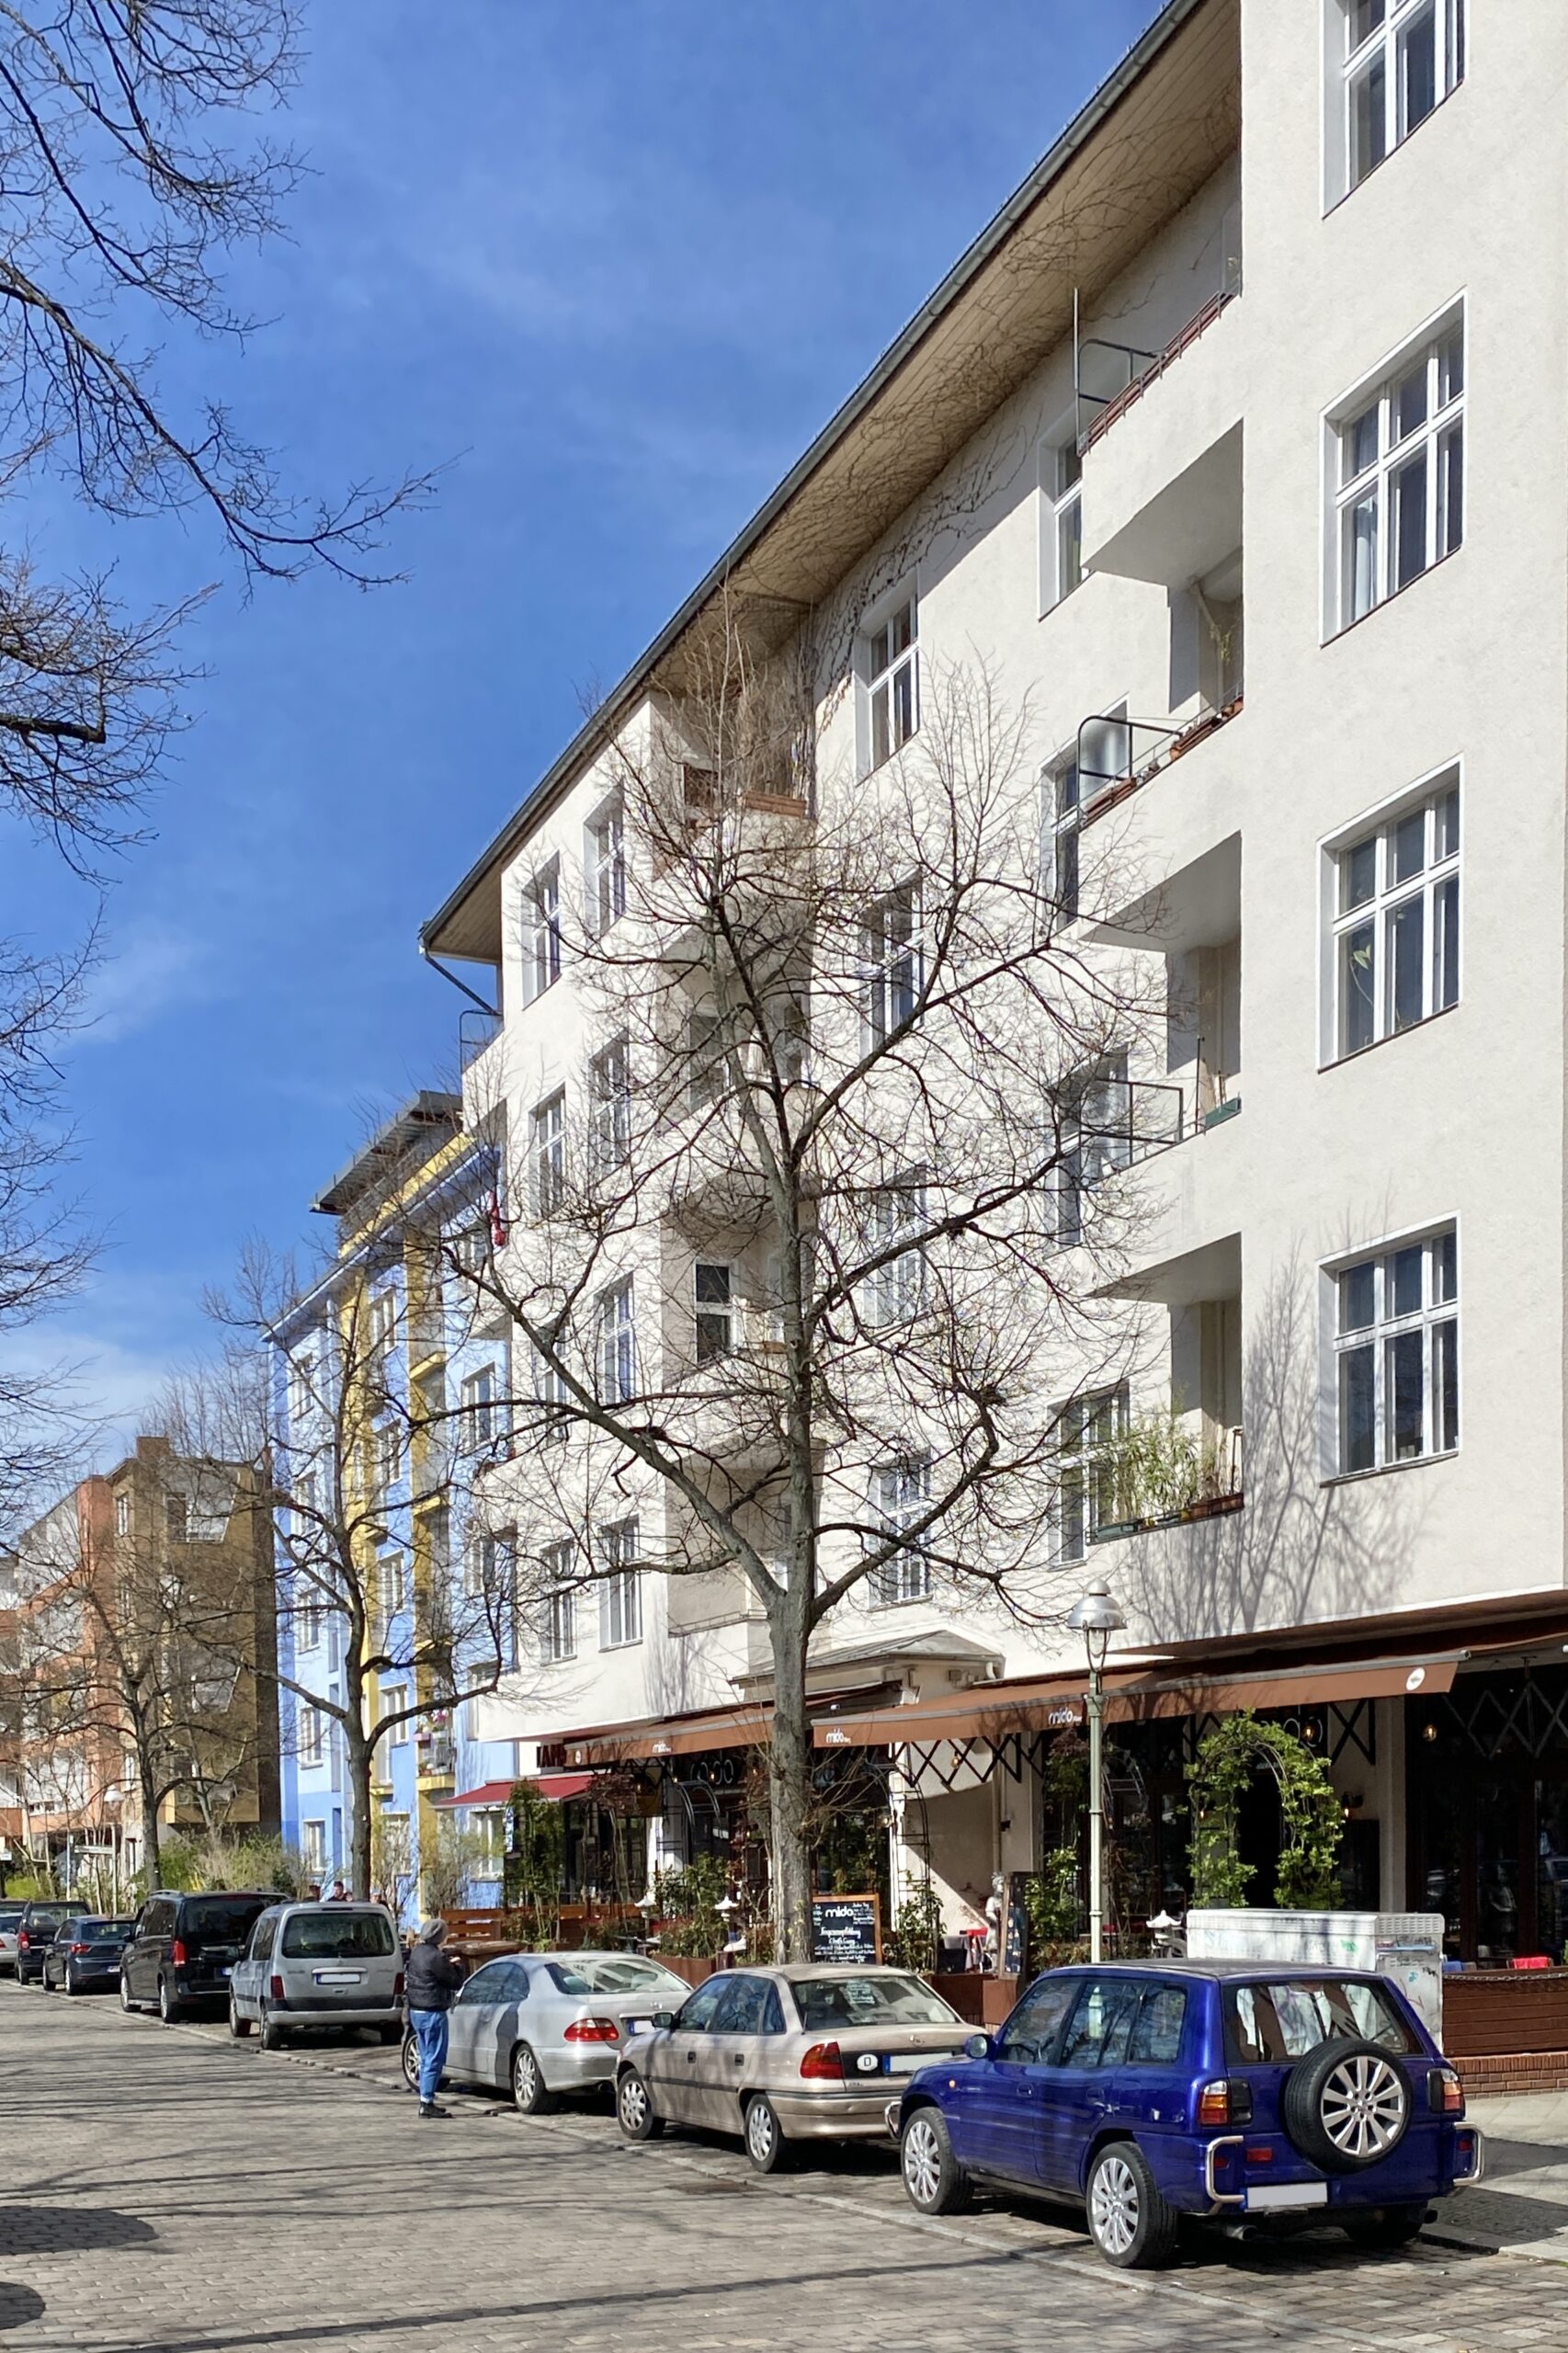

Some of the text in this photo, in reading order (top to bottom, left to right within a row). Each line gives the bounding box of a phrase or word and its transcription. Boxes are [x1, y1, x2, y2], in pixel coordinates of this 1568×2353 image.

[1049, 1707, 1073, 1725] mido
[825, 1728, 844, 1743] mido
[824, 1905, 854, 1917] mido
[864, 2057, 871, 2067] D
